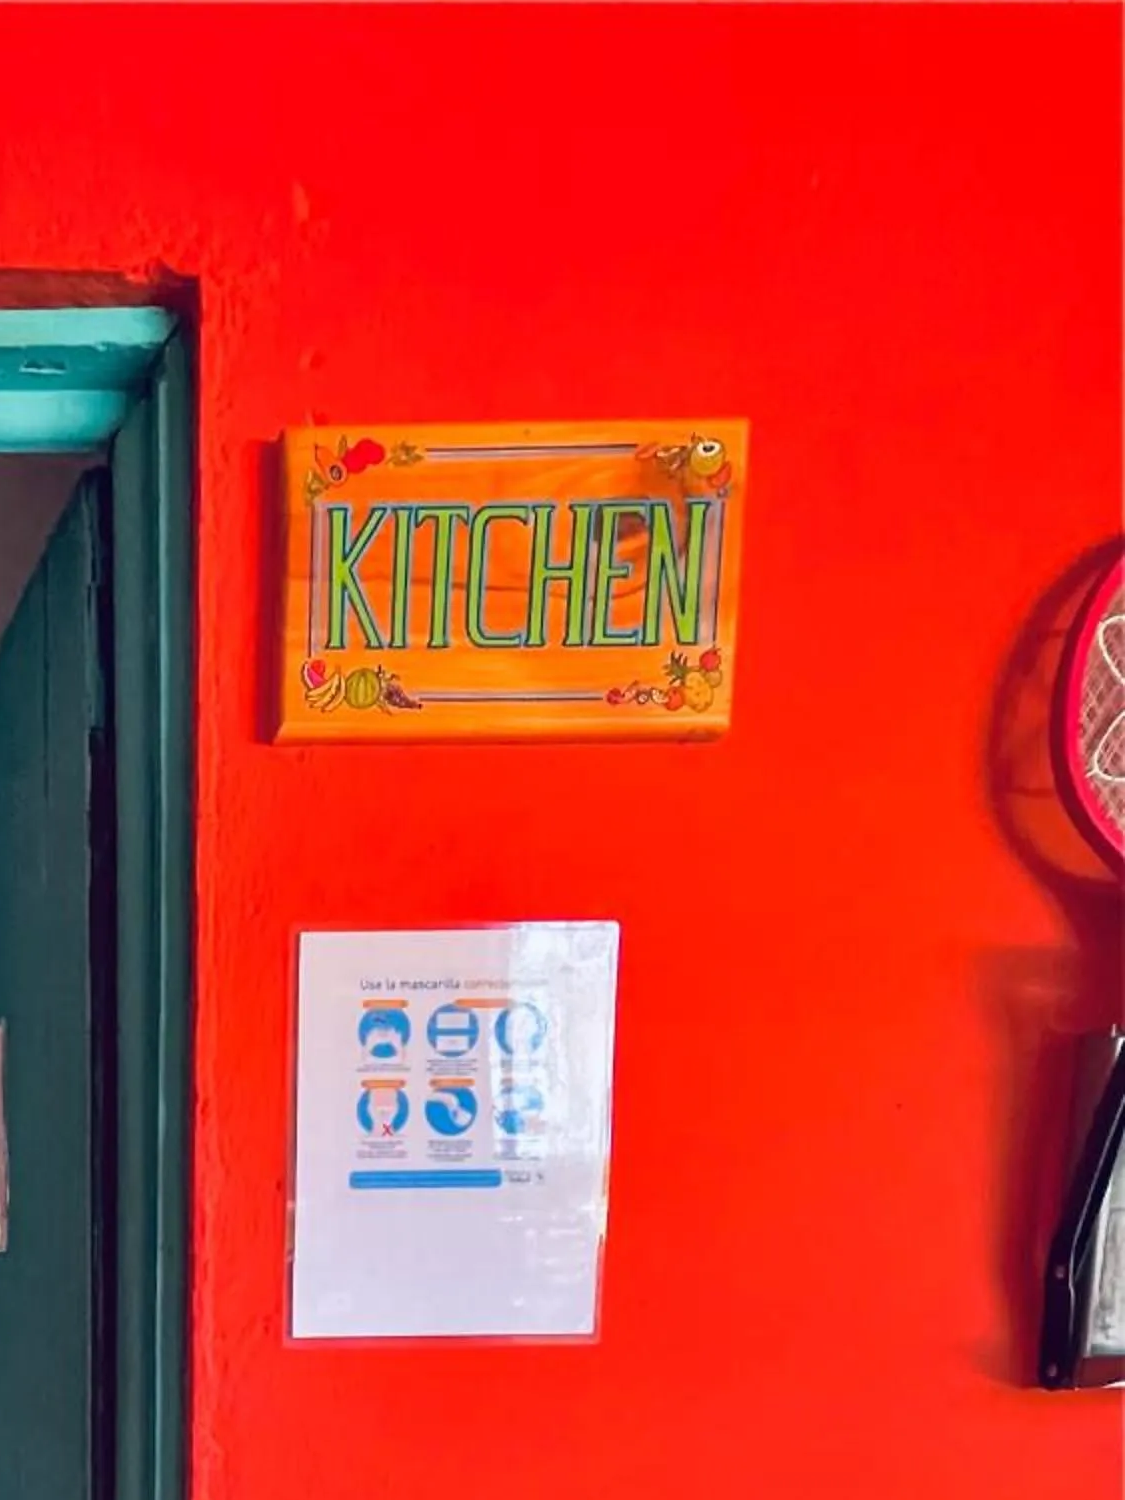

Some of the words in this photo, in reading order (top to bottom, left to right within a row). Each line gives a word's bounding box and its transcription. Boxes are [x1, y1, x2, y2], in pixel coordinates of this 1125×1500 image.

[325, 501, 711, 648] KITCHEN
[360, 979, 382, 991] Use
[386, 978, 396, 991] la
[400, 978, 461, 991] mascarilla
